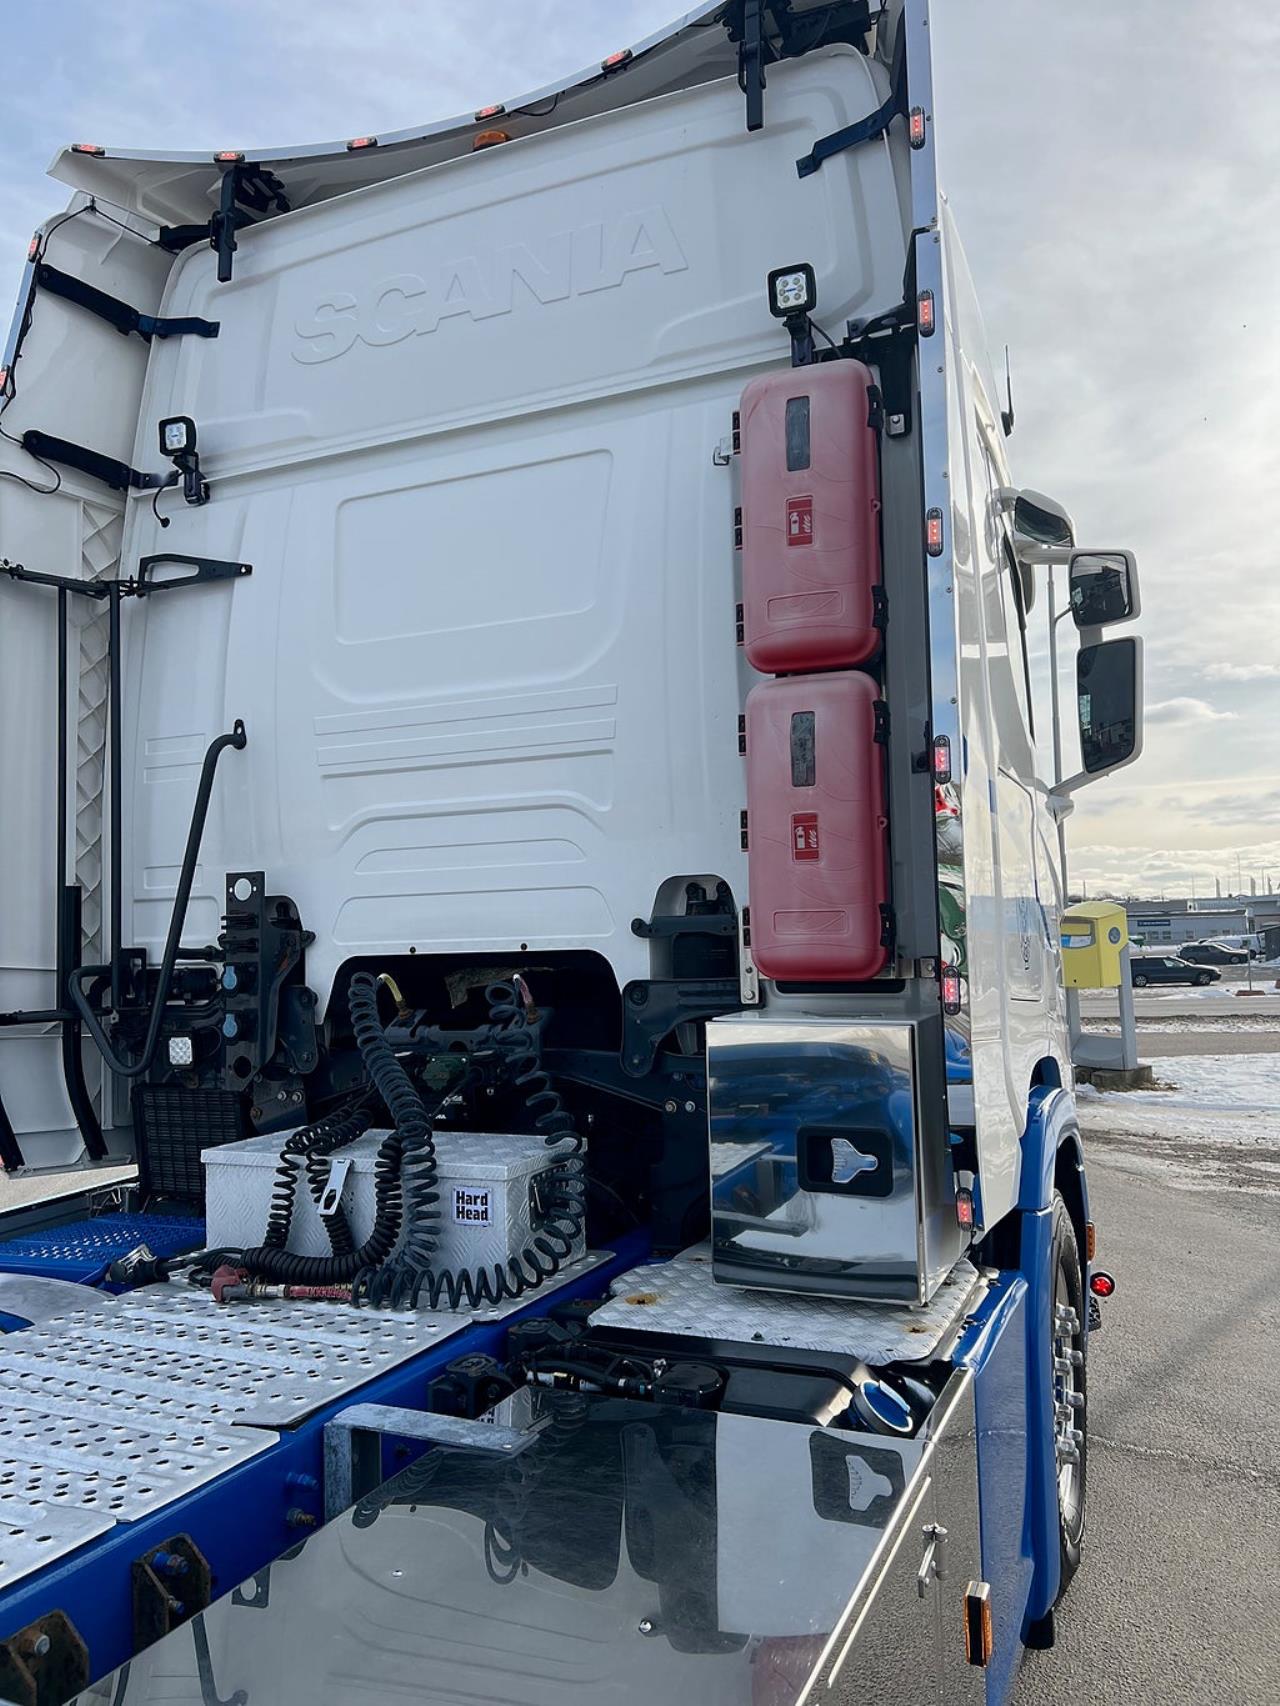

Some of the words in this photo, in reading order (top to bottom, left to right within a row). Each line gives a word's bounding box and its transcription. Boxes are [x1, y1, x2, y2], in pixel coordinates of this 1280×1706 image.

[291, 204, 690, 365] SCANIA
[456, 1190, 488, 1206] Hard
[456, 1205, 488, 1221] Head
